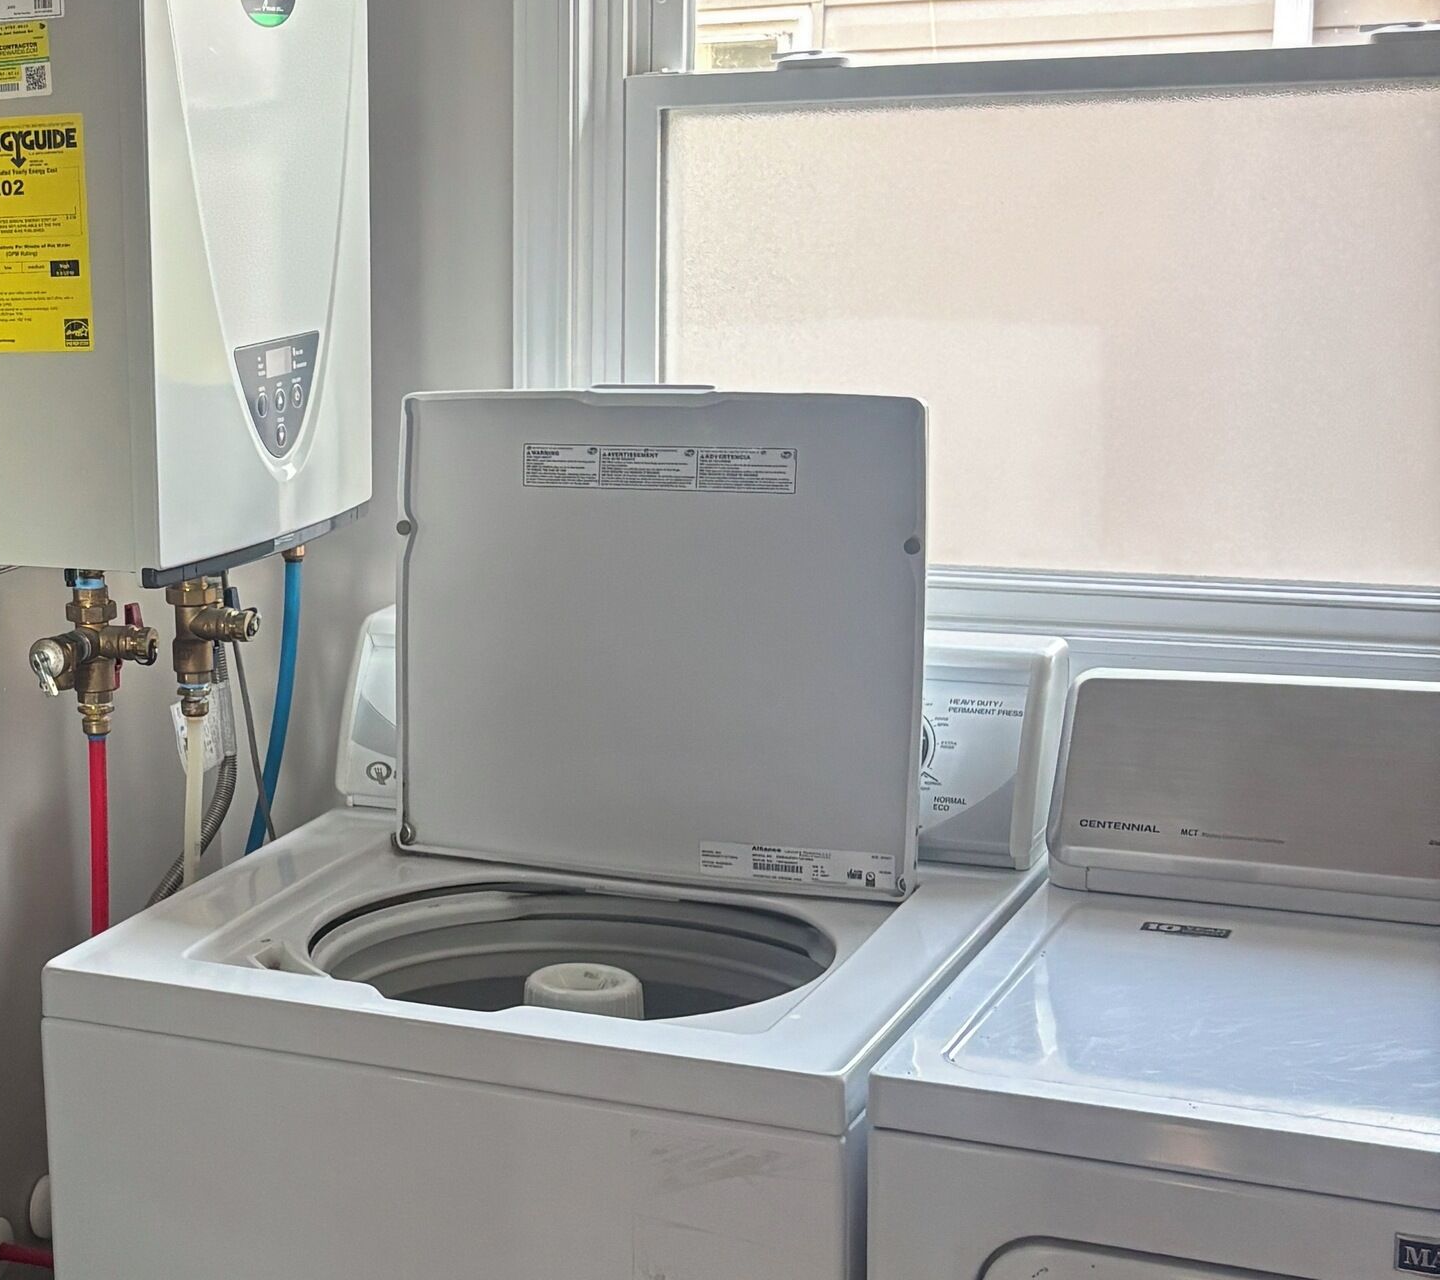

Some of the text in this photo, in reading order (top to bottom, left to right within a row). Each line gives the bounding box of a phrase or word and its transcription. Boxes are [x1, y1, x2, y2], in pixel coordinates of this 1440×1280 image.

[949, 698, 976, 706] HEAVY
[948, 706, 1024, 718] PERMANENT PRESS
[933, 796, 967, 806] NORMAL
[932, 804, 950, 812] ECO
[1078, 818, 1199, 837] CENTENNIAL MCT
